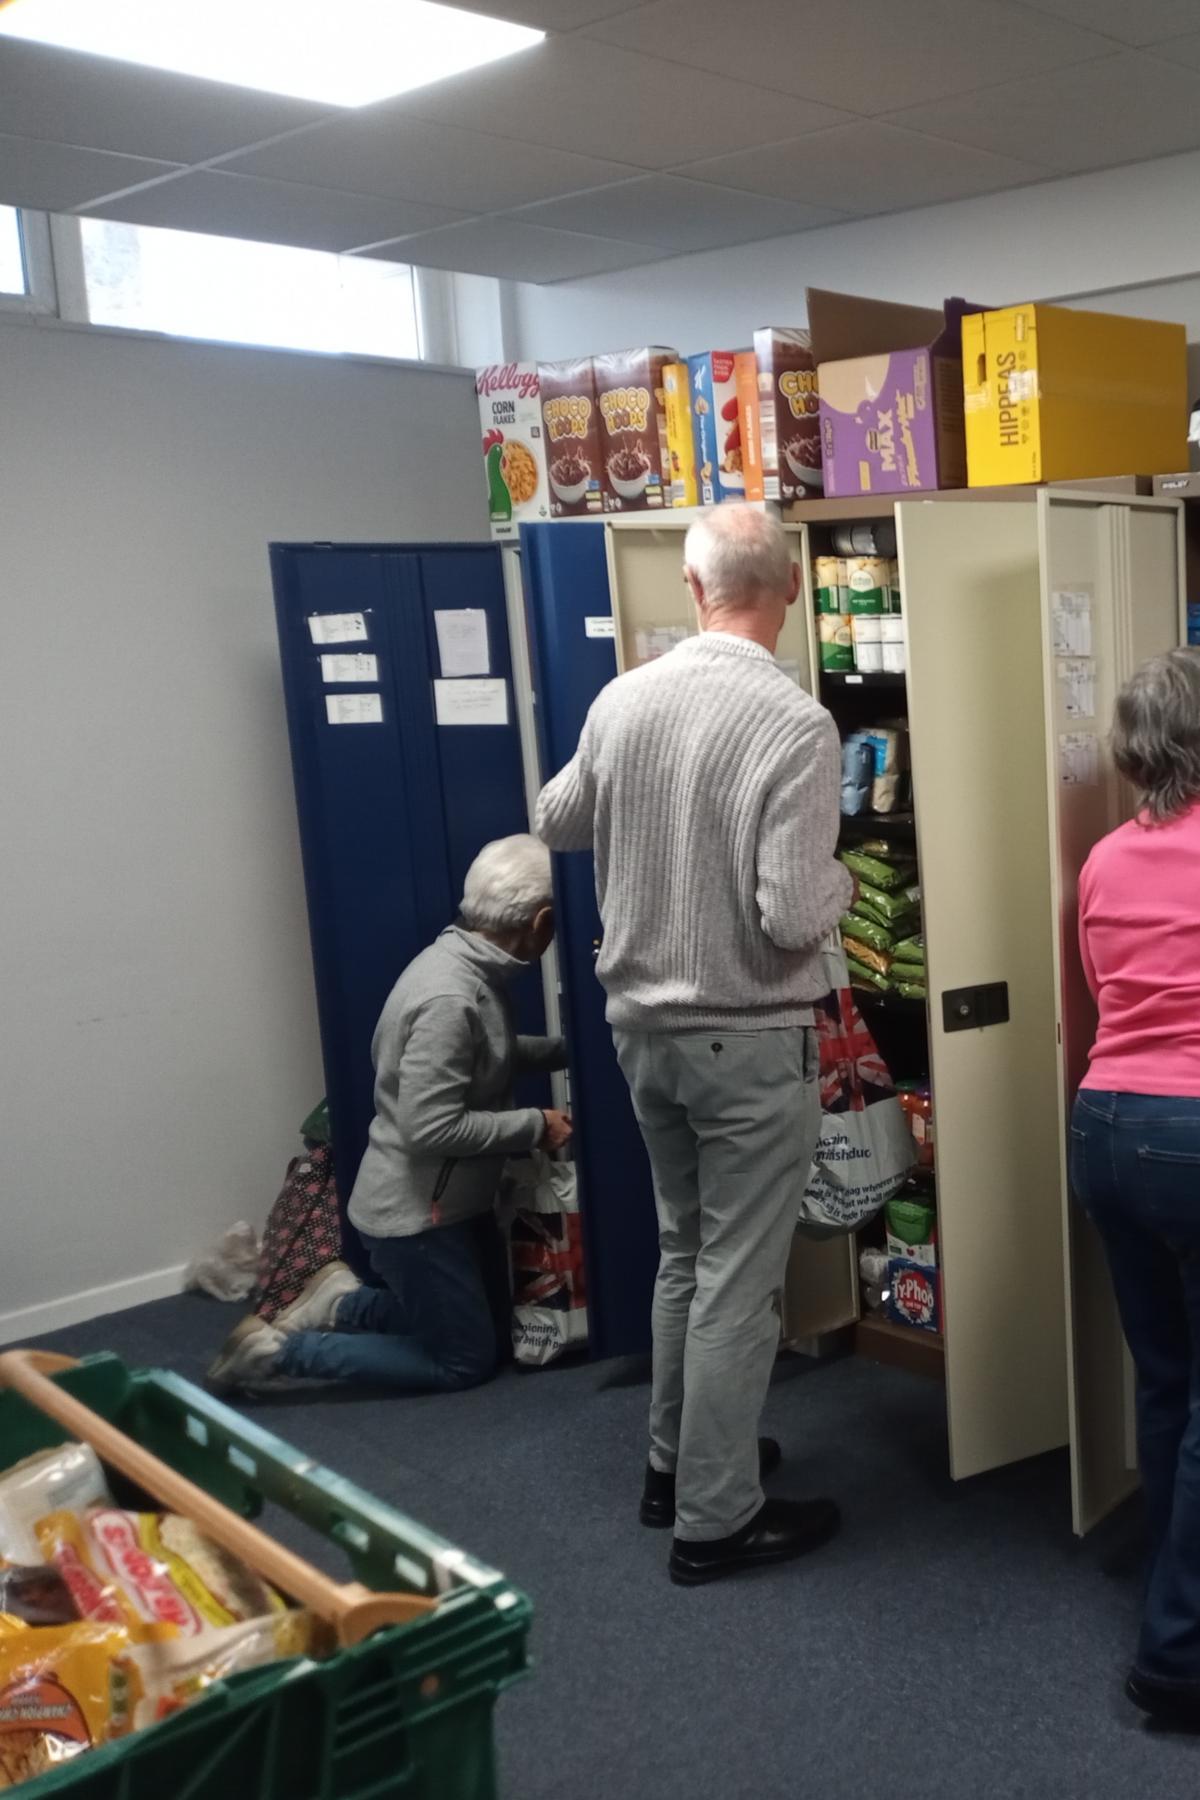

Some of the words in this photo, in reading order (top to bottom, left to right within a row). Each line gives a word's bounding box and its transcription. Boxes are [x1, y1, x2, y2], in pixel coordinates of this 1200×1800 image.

[492, 400, 515, 414] CORN
[544, 397, 590, 421] CHOCO
[601, 388, 649, 413] CHOCO
[996, 351, 1019, 447] HIPPEAS
[493, 415, 515, 424] FLAKES
[548, 415, 588, 440] HOOPS
[605, 410, 647, 435] HOOPS
[877, 409, 897, 472] MAX
